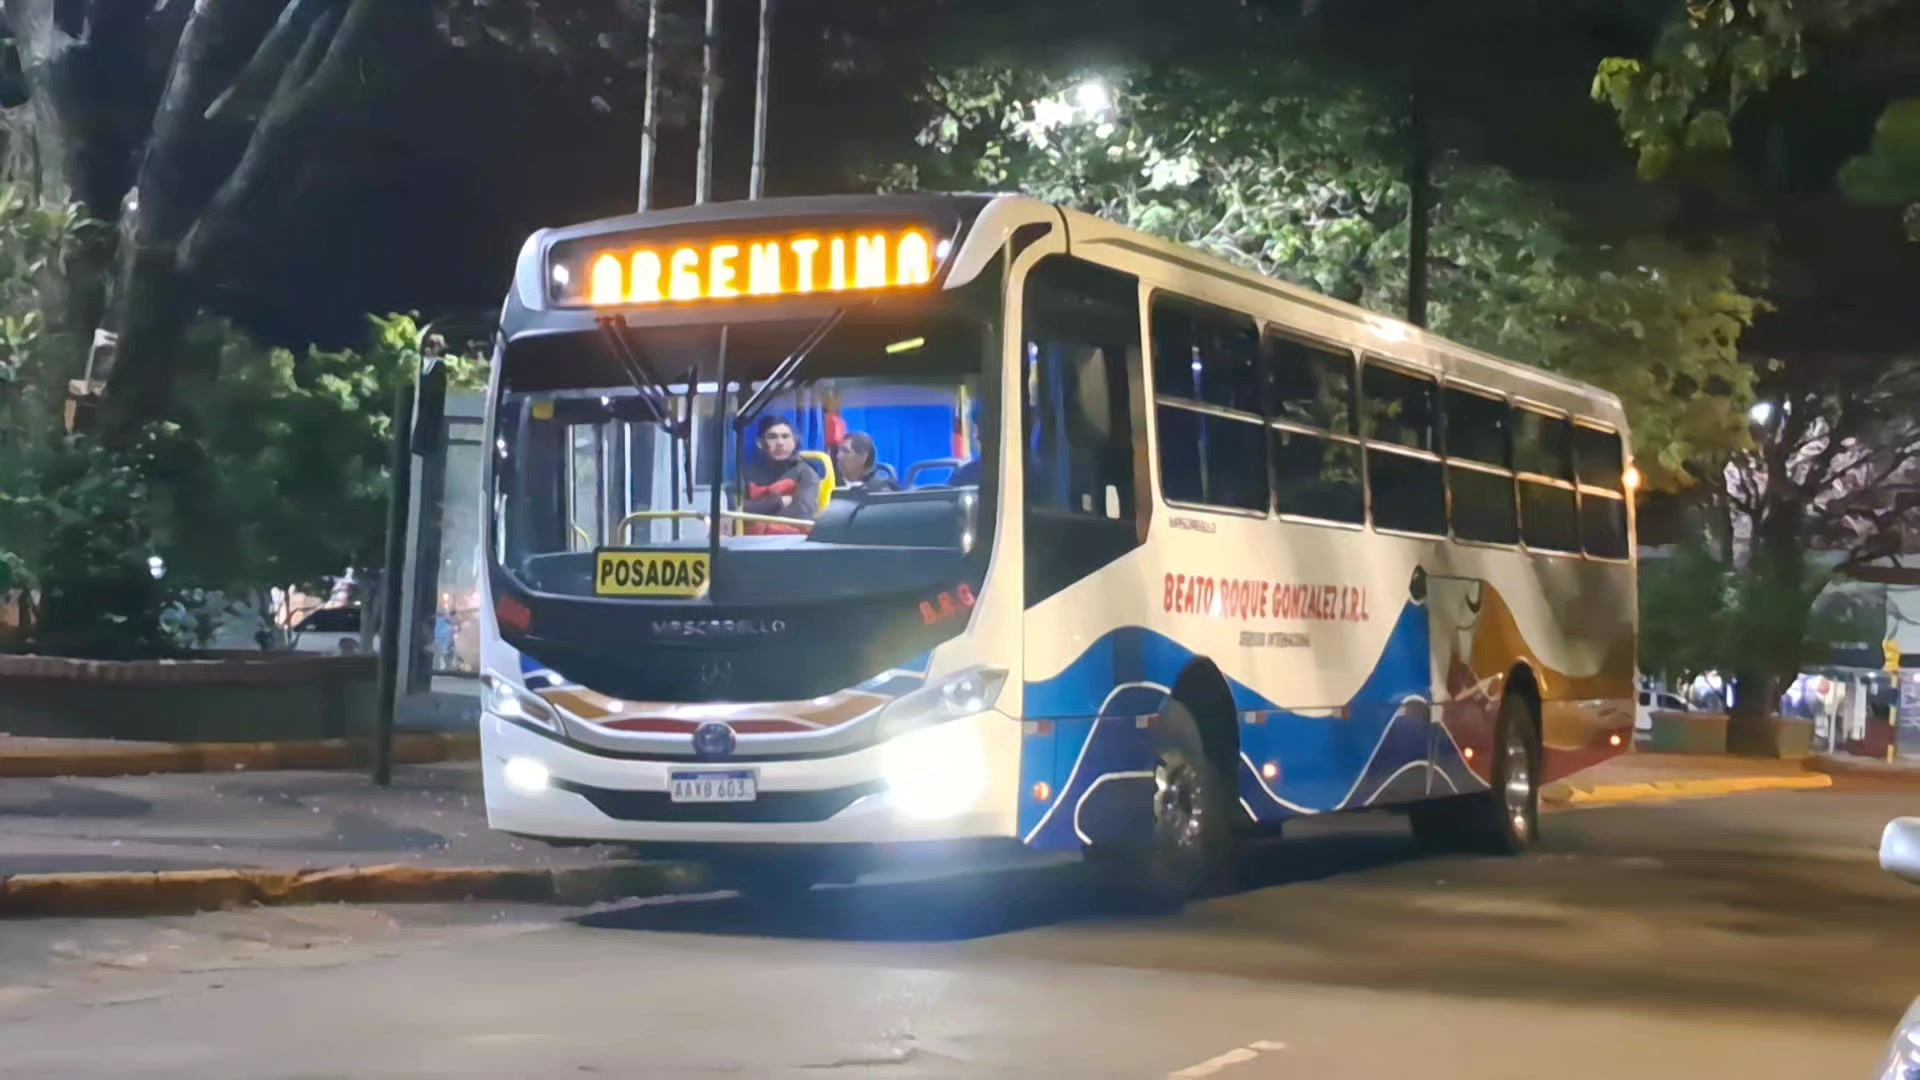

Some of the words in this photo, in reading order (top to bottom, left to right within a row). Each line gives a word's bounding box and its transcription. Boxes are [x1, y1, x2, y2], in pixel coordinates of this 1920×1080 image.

[590, 229, 932, 306] ARGENTINA
[599, 558, 707, 588] POSADAS
[1163, 571, 1214, 615] BEATO
[1219, 577, 1269, 622] ROQUE
[1272, 582, 1338, 621] GONZALEZ
[716, 780, 746, 798] 603
